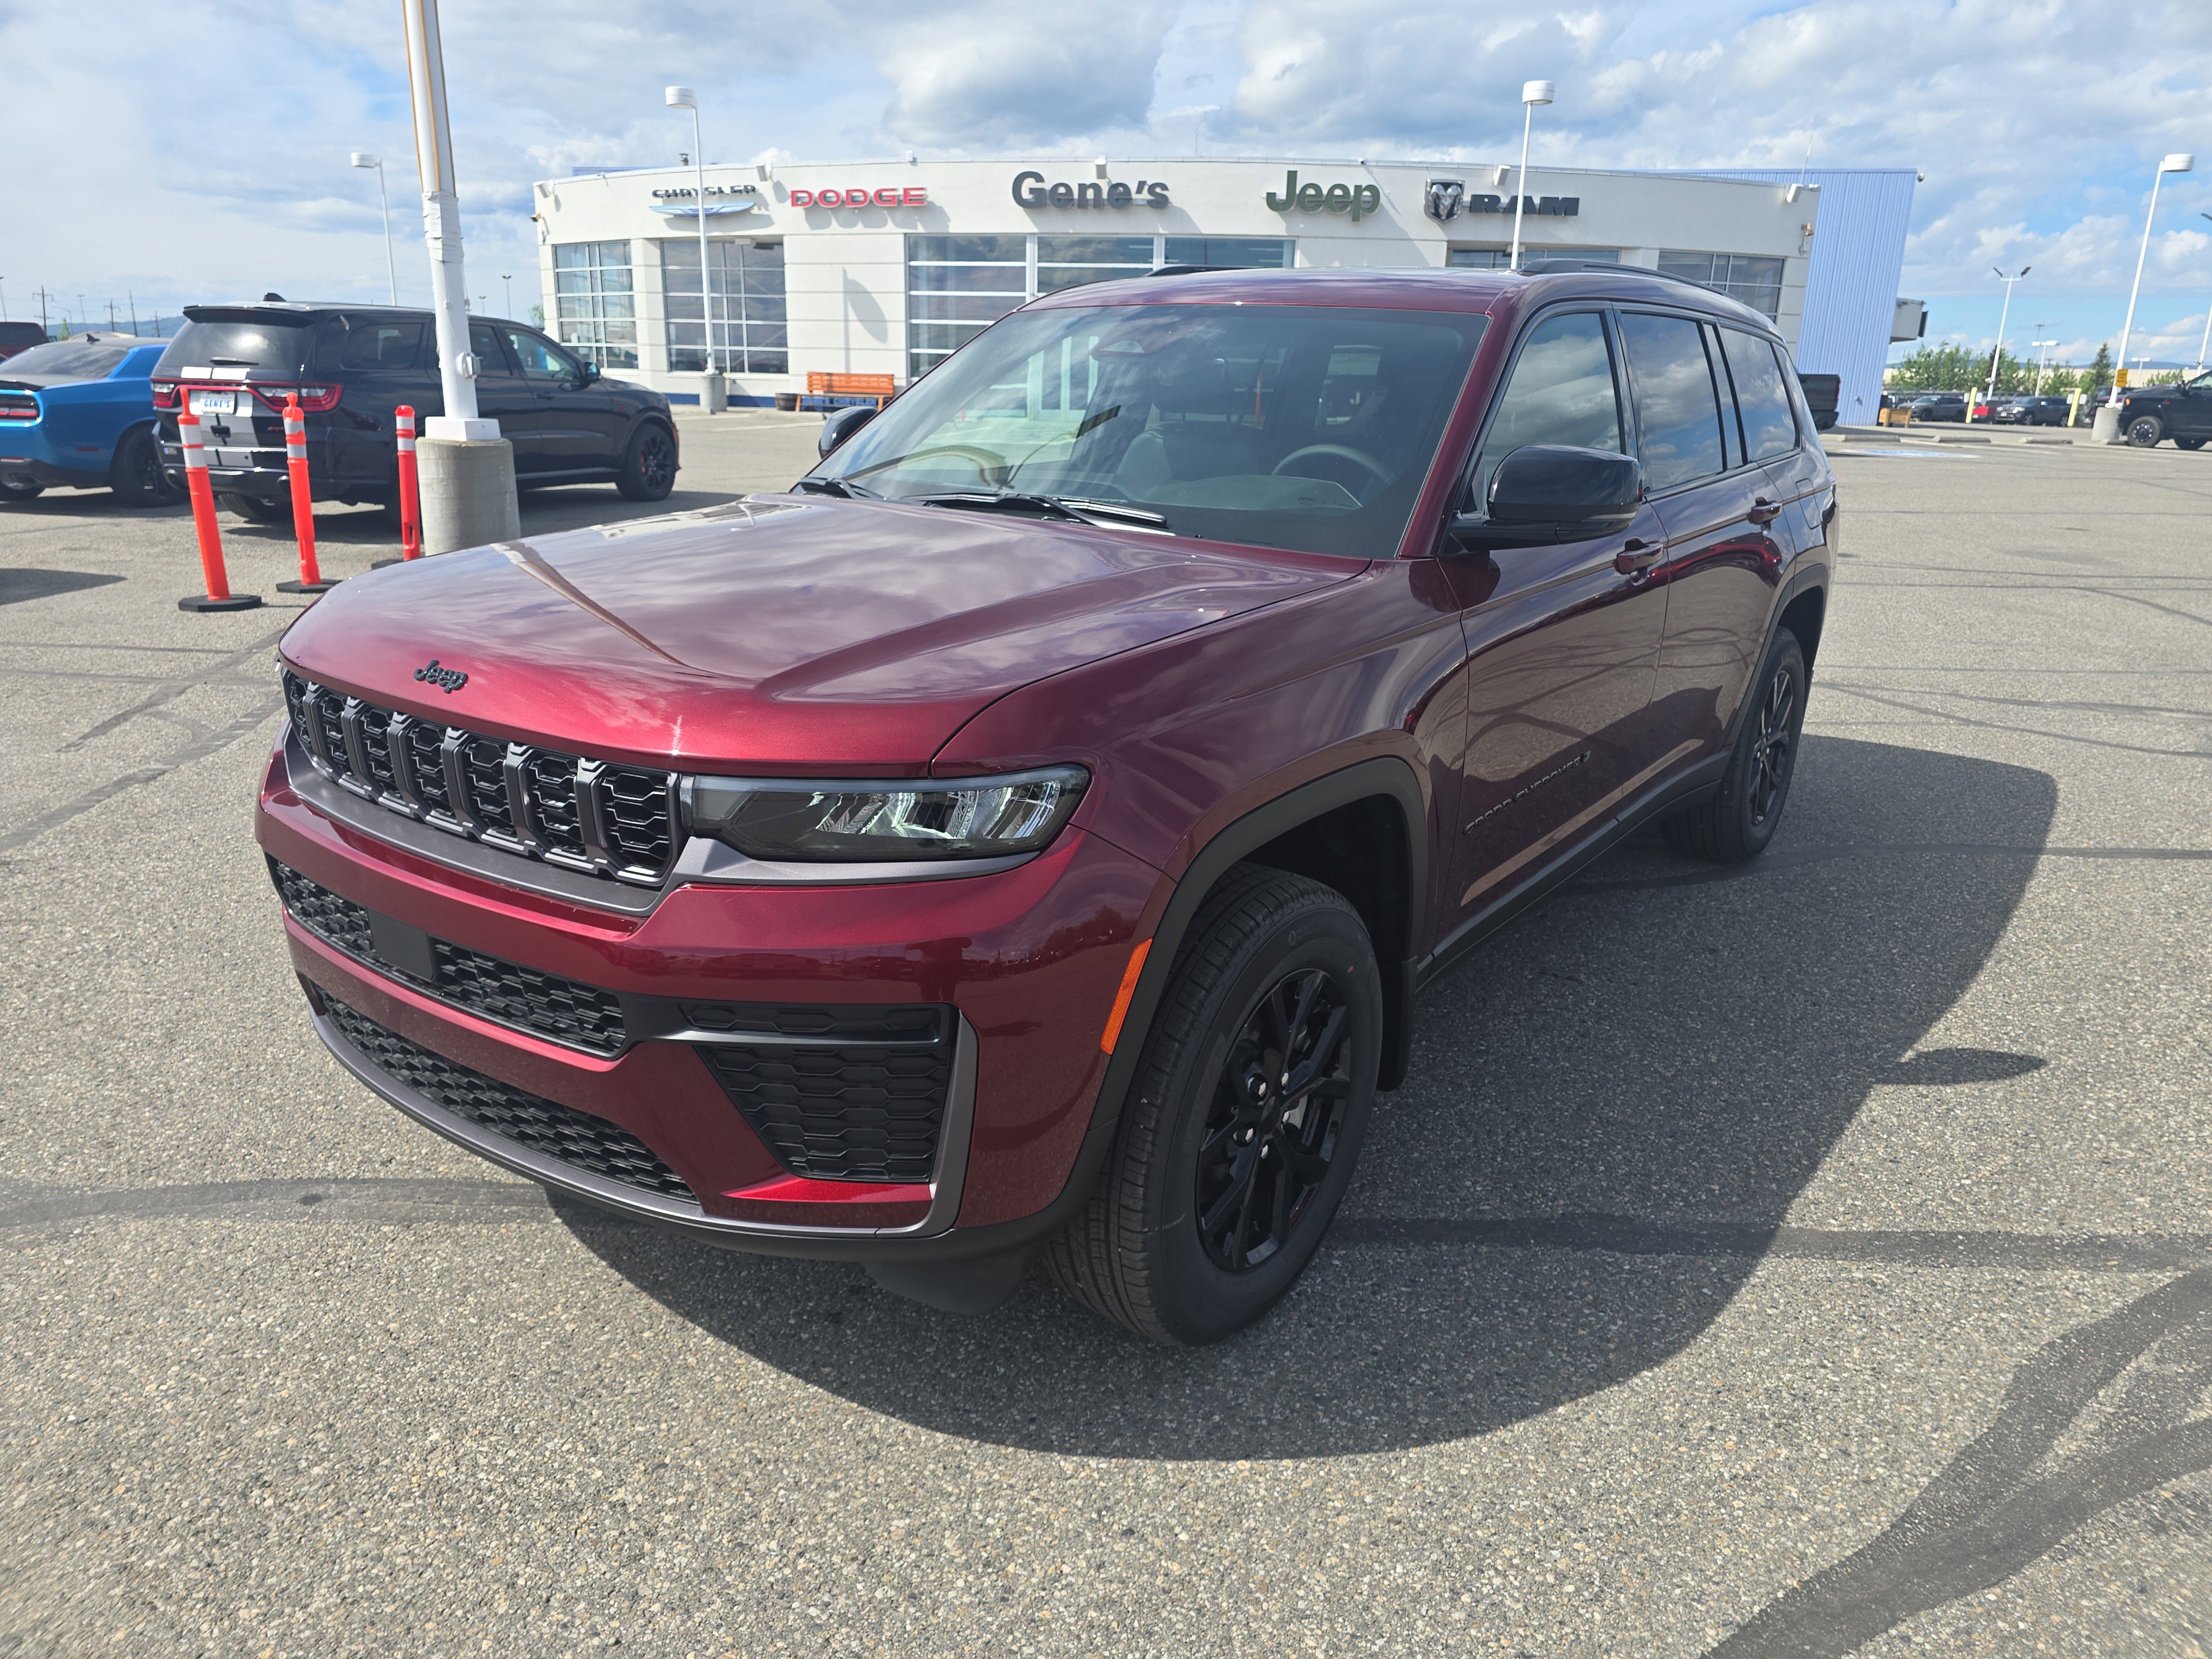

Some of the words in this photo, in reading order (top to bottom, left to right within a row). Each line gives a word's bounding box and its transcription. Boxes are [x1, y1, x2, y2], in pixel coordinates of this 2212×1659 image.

[790, 187, 927, 208] DODGE
[1012, 171, 1170, 209] Gene's
[1266, 170, 1380, 222] Jeep
[1469, 194, 1580, 216] RAM
[414, 659, 468, 694] Jeep
